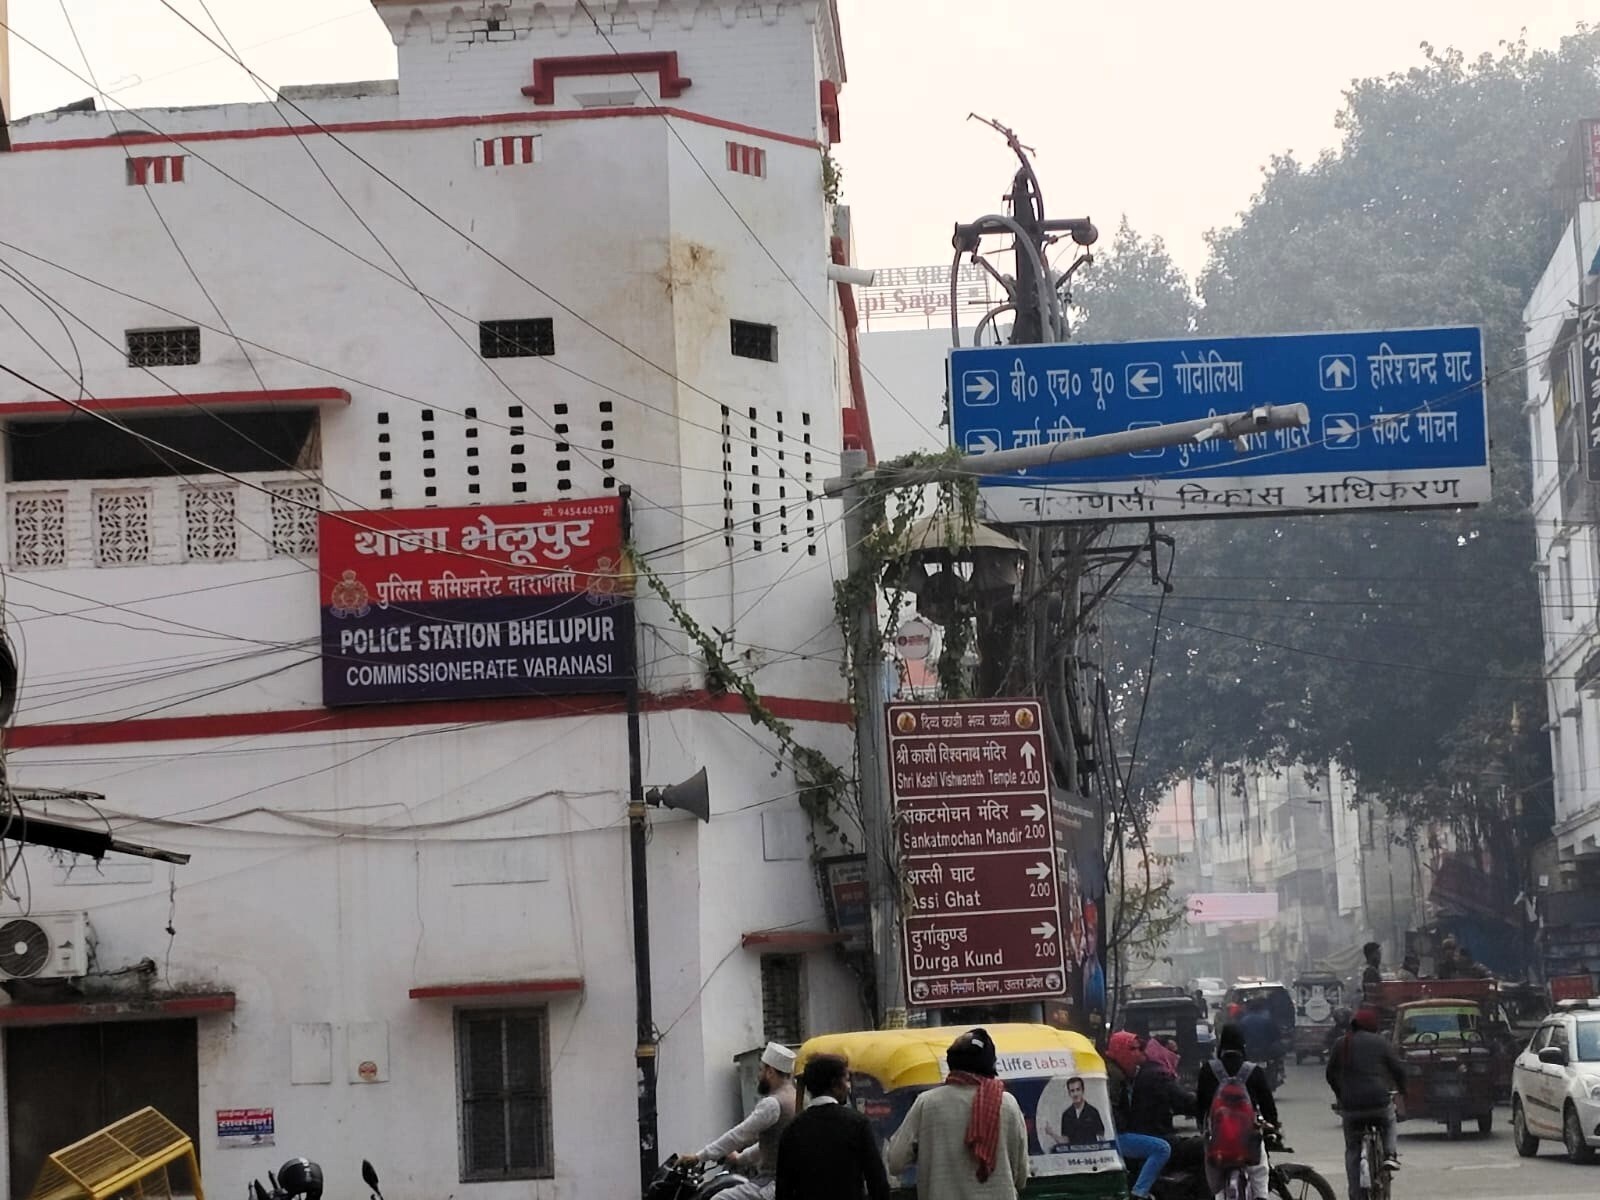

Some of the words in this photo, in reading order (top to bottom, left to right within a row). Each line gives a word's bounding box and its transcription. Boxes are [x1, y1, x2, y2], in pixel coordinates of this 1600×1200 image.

[1443, 351, 1472, 382] घाट
[1370, 405, 1411, 445] संकट
[1416, 400, 1458, 443] मोचन
[1176, 483, 1285, 510] विकास
[1305, 476, 1460, 504] प्राधिकरण
[354, 527, 450, 557] थाना
[461, 514, 595, 565] भेलूपुर
[376, 572, 422, 610] पुलिस
[428, 569, 503, 600] कमिश्नरेट
[508, 567, 577, 596] वाराणसी
[340, 626, 412, 655] POLICE
[418, 621, 501, 652] STATION
[508, 616, 615, 647] BHELUPUR
[346, 658, 519, 687] COMMISSIONERATE
[523, 653, 613, 678] VARANASI
[896, 743, 909, 766] श्री
[911, 742, 937, 764] काशी
[939, 742, 980, 764] विश्वनाथ
[982, 740, 1007, 761] मंदिर
[897, 772, 914, 789] Shri
[916, 771, 938, 788] Kashi
[940, 769, 984, 788] Vishwanath
[988, 768, 1017, 788] Temple
[1020, 770, 1040, 785] 2.00
[902, 802, 970, 825] संकटमोचन
[976, 800, 1009, 821] मंदिर
[903, 829, 983, 849] Sankatmochan
[986, 827, 1023, 845] Mandir
[1024, 824, 1046, 840] 2.00
[907, 862, 943, 885] अस्सी
[950, 867, 975, 882] घाट
[911, 893, 939, 910] Assi
[944, 890, 982, 908] Ghat
[1030, 882, 1051, 897] 2.00
[911, 923, 968, 951] दुर्गाकुण्ड
[1035, 942, 1056, 957] 2.00
[913, 953, 959, 972] Durga
[965, 949, 1003, 967] Kund
[931, 979, 949, 996] लोक
[1034, 1055, 1068, 1070] labs
